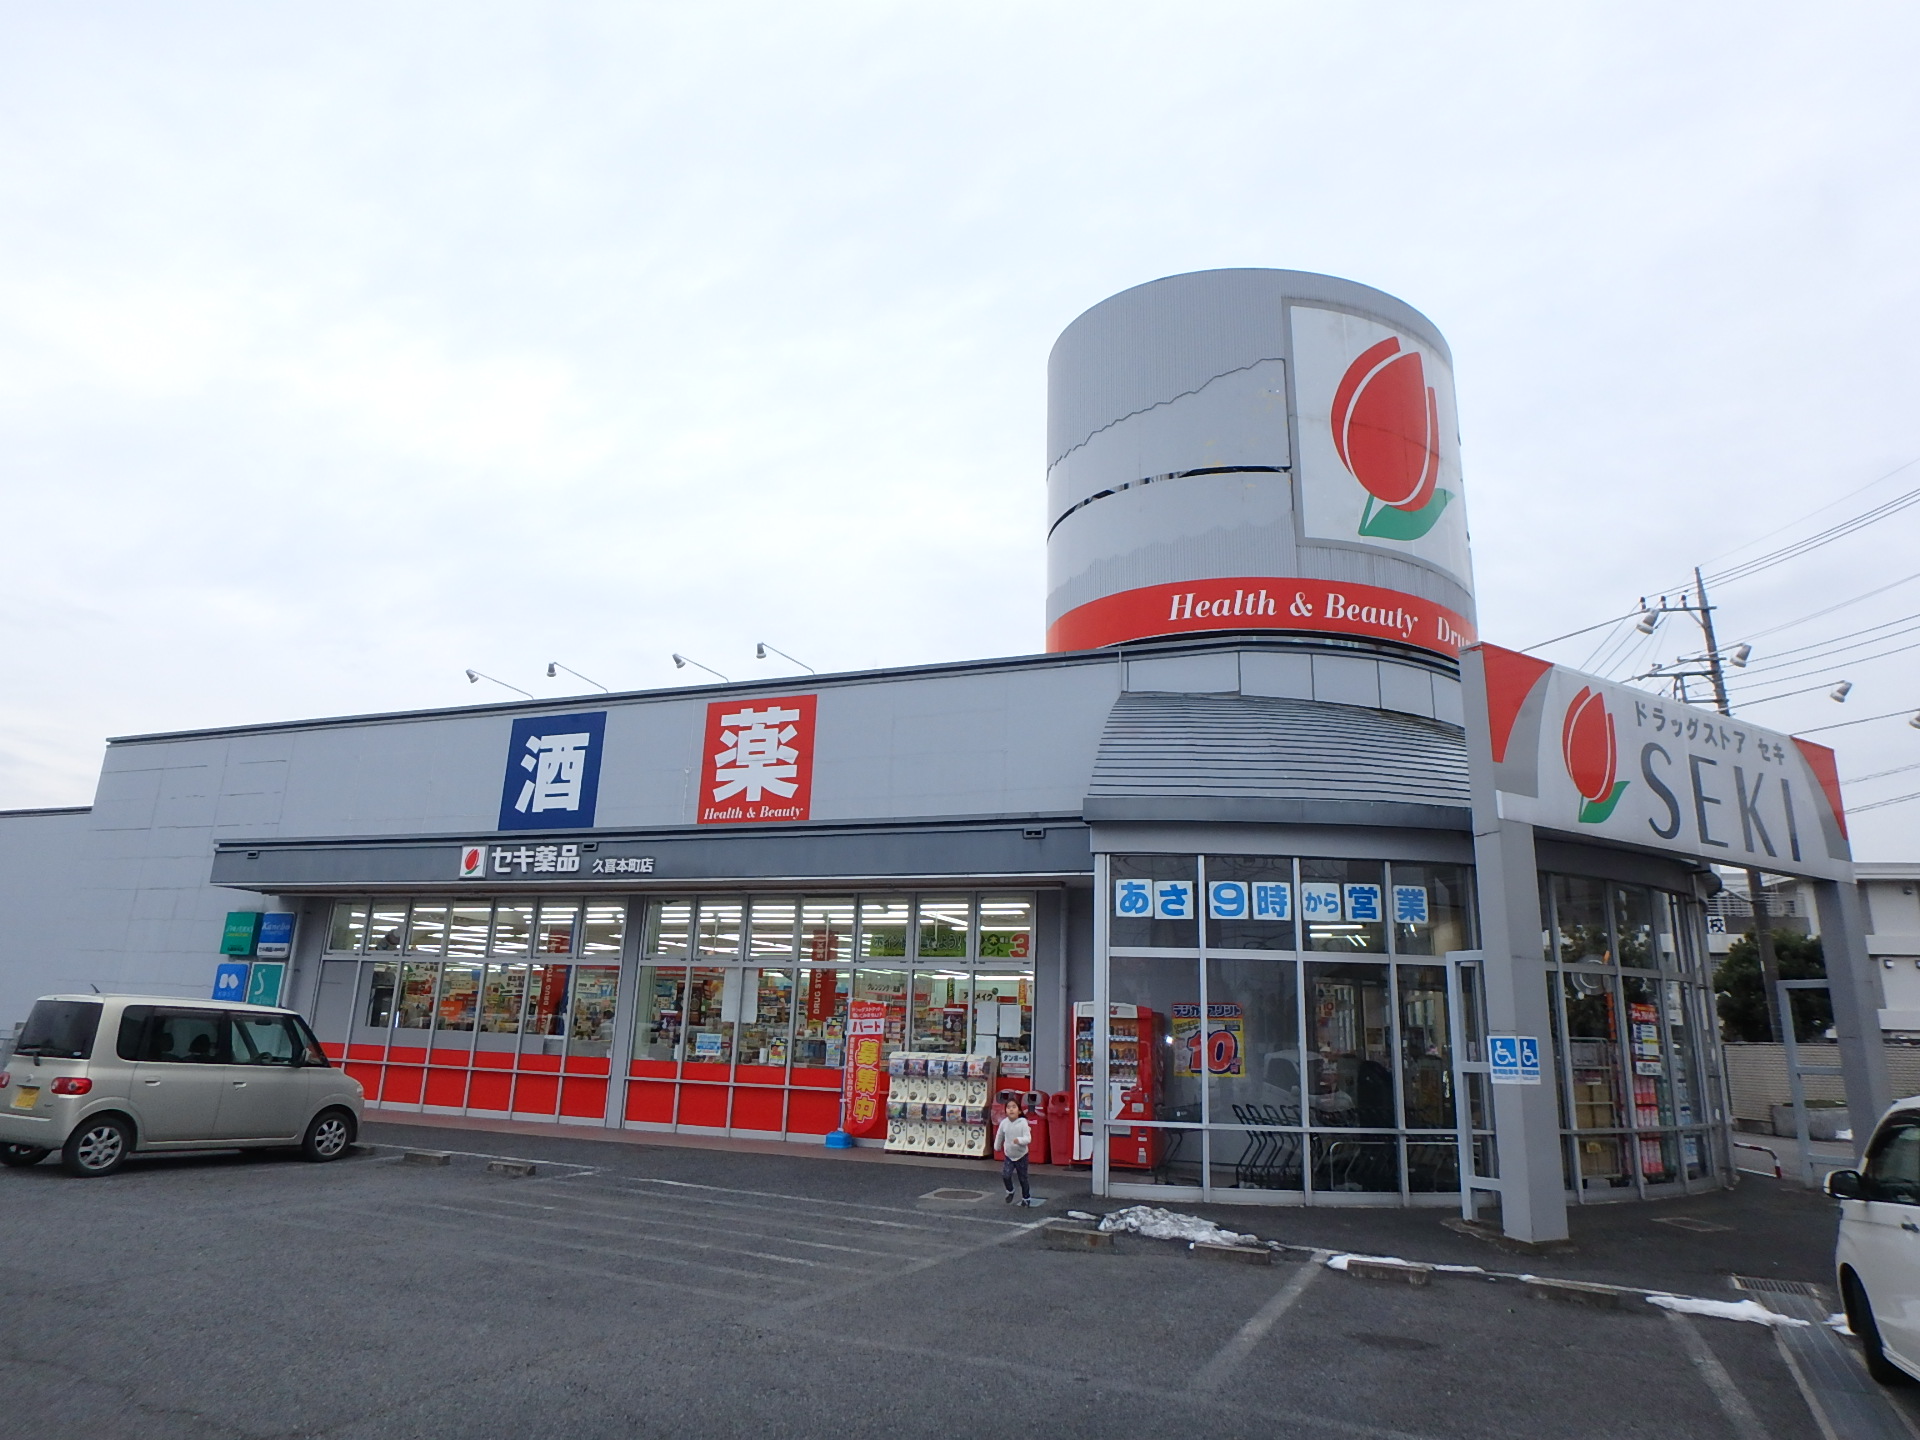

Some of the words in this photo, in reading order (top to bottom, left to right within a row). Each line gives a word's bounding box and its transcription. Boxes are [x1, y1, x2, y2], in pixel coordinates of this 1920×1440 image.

[1168, 589, 1277, 621] Health
[1288, 592, 1314, 617] &
[1324, 593, 1419, 639] Beauty
[1635, 701, 1746, 755] ドラッグストア
[1757, 737, 1786, 766] セキ
[514, 731, 591, 814] 酒
[712, 706, 801, 803] 薬
[703, 806, 743, 820] Health
[746, 807, 756, 819] &
[759, 805, 804, 821] Beauty
[1640, 742, 1801, 863] SEKI
[491, 844, 580, 873] セキ薬品
[592, 856, 654, 874] 久喜本町店
[1009, 932, 1030, 958] 3
[1709, 917, 1725, 933] 校
[543, 985, 552, 1005] DRUG
[813, 991, 821, 1015] DRUG
[856, 1040, 880, 1122] 募集中
